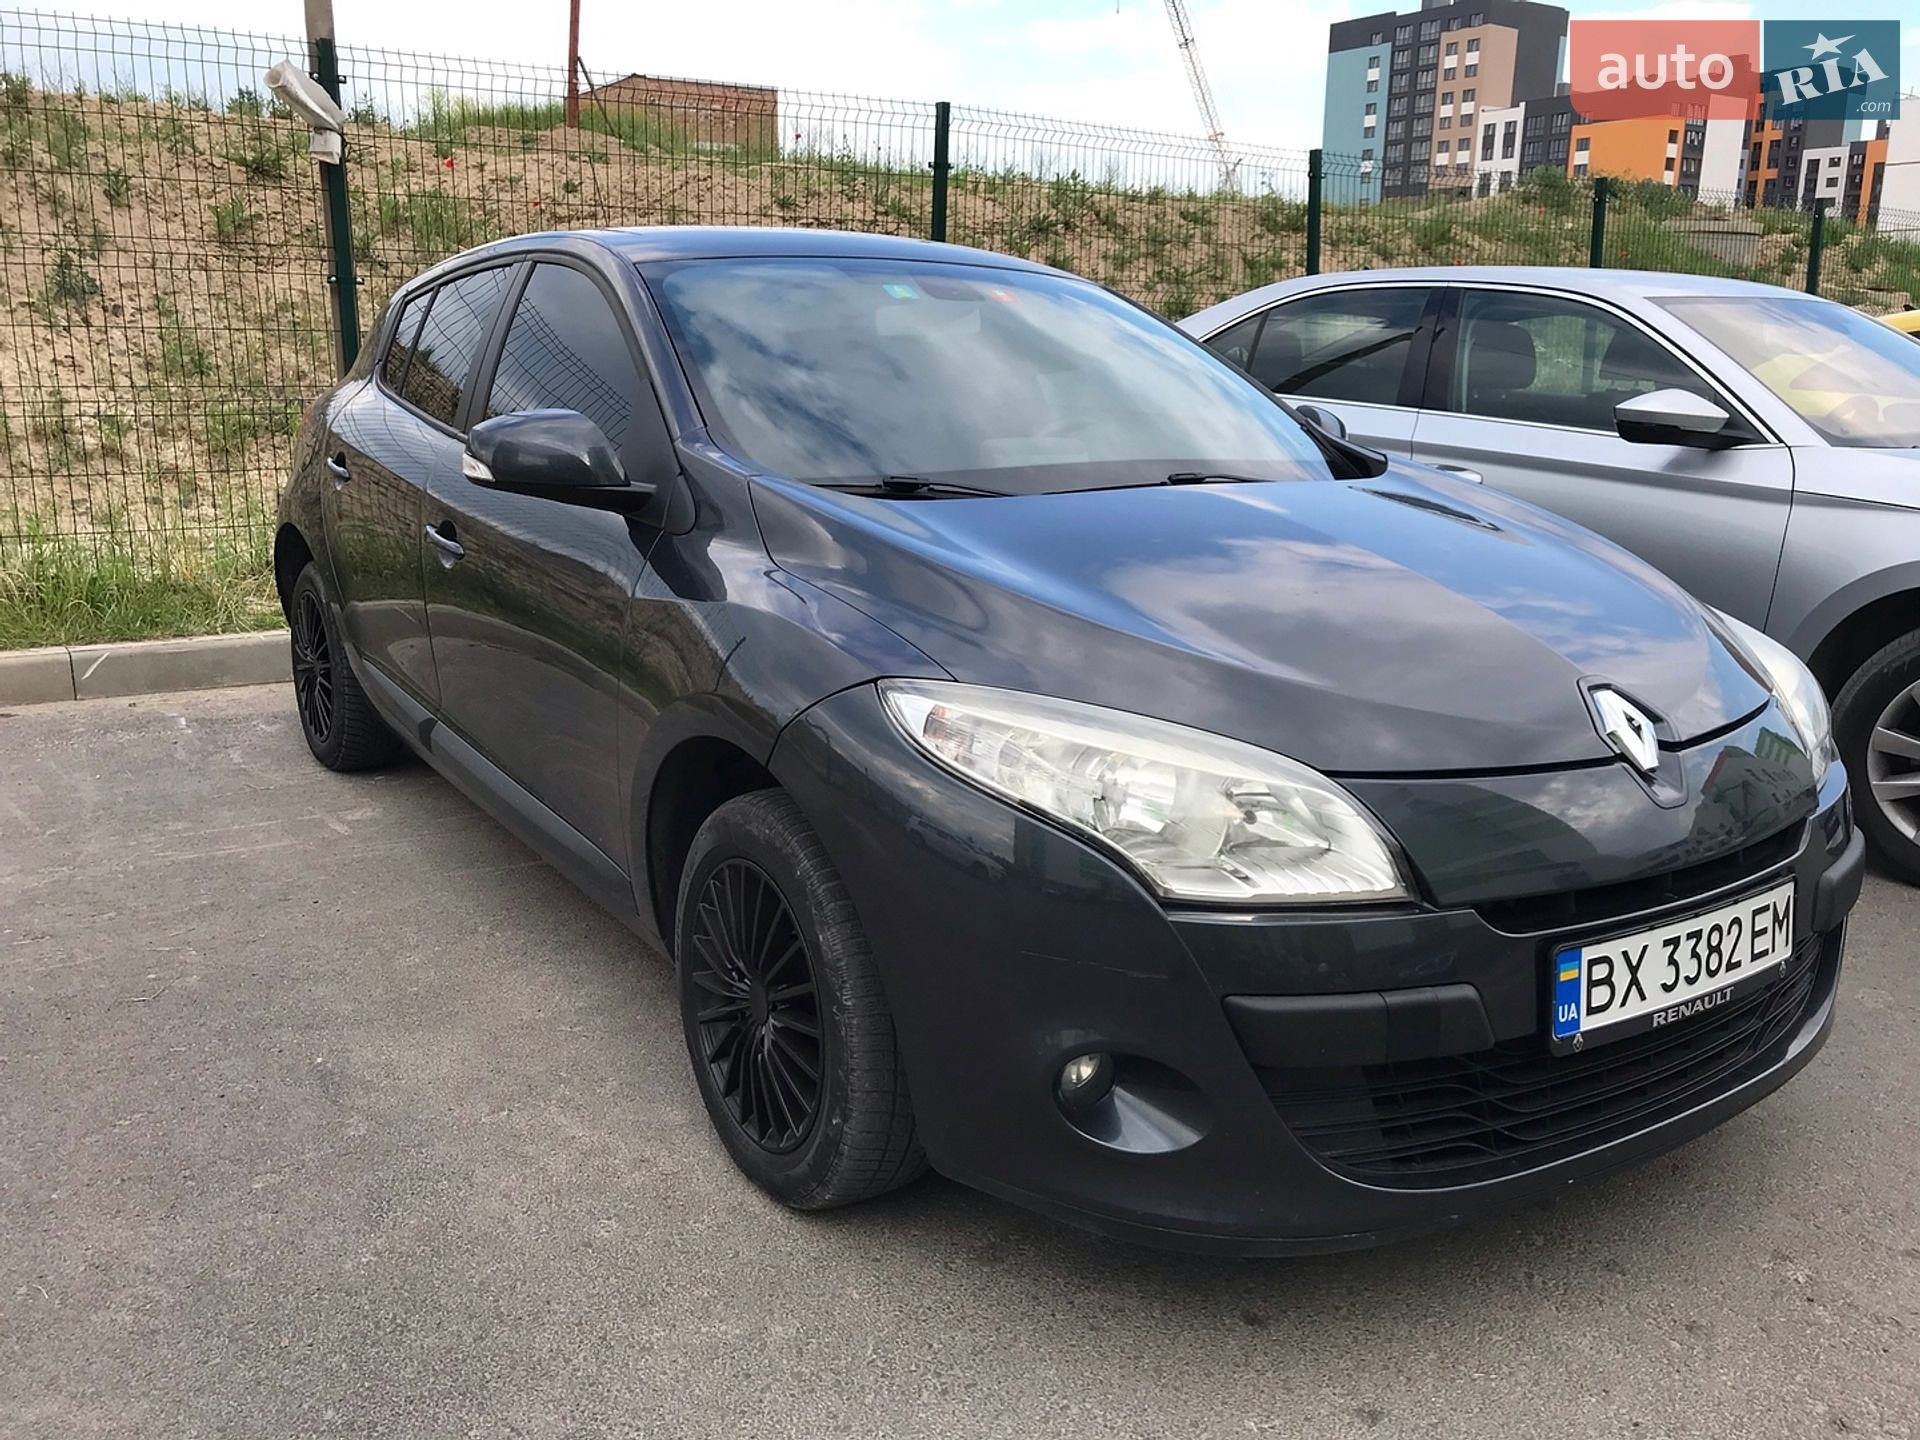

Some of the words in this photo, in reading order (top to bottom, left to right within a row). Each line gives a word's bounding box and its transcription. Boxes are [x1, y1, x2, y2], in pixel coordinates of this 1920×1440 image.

[1585, 944, 1649, 1016] BX
[1660, 916, 1743, 993] 3382
[1750, 895, 1791, 963] EM
[1558, 1002, 1578, 1023] UA
[1652, 986, 1736, 1028] RENAULT
